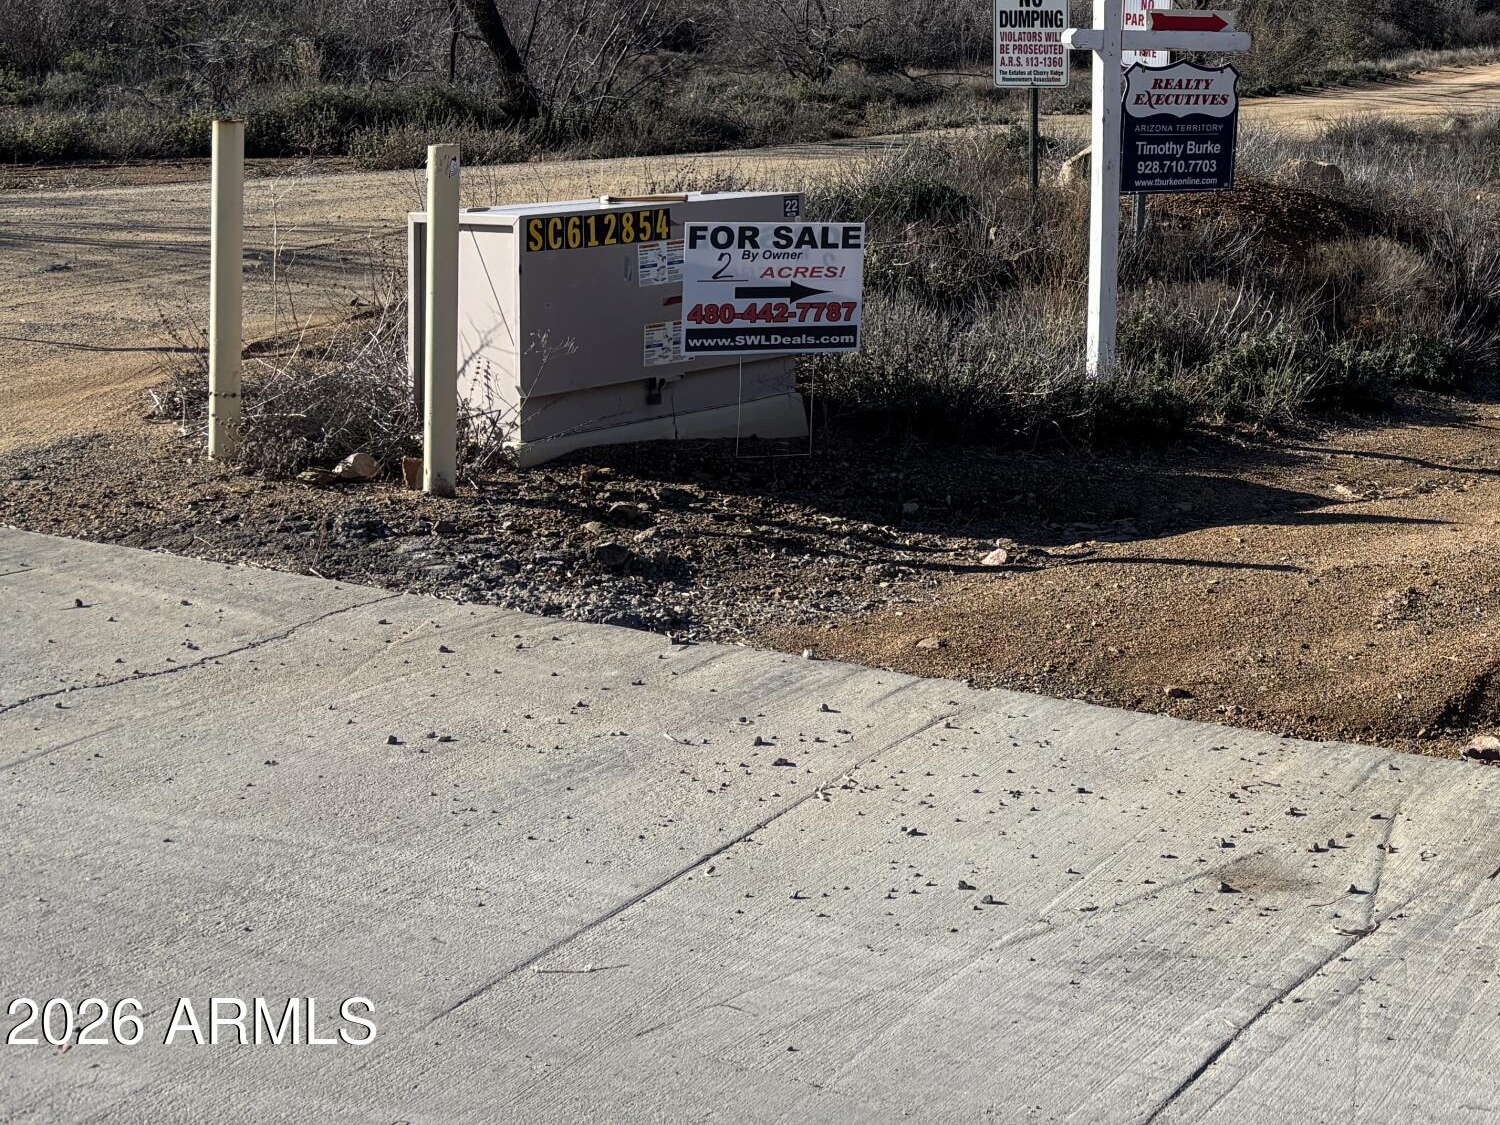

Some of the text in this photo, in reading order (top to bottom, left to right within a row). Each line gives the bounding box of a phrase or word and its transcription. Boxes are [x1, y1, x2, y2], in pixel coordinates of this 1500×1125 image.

[1000, 10, 1064, 28] DUMPING
[1000, 31, 1042, 42] VIOLATORS
[1000, 44, 1064, 54] BE PROSECUTED
[1000, 56, 1023, 67] A.R.S.
[1033, 69, 1049, 77] Cherry
[1151, 78, 1214, 90] REALTY
[1133, 90, 1229, 109] EXECUTIVES
[1134, 124, 1224, 132] ARIZONA TERRITORY
[1136, 140, 1221, 157] Timothy Burke
[1137, 160, 1217, 174] 928.710.7703
[1134, 177, 1217, 187] www.tburkeonline.com
[785, 199, 798, 212] 22
[528, 209, 669, 251] SC612854
[688, 226, 862, 250] FOR SALE
[742, 249, 803, 262] By Owner
[712, 252, 845, 280] 2 ACRES!
[687, 302, 858, 325] 480-442-7787
[688, 334, 854, 347] www.SWLDeals.com
